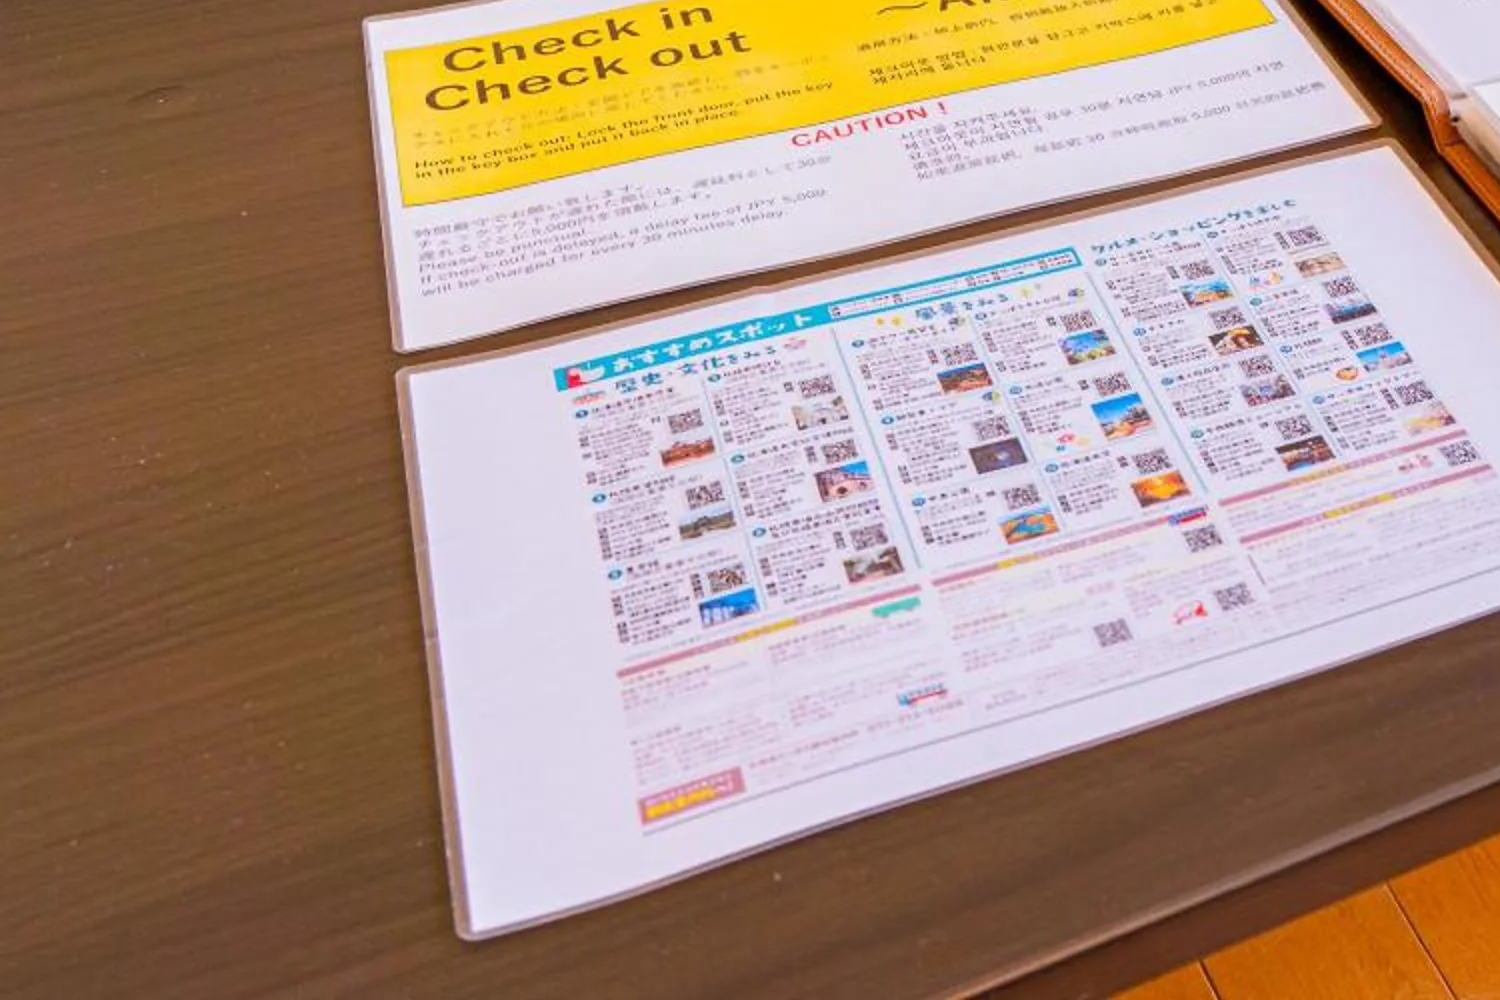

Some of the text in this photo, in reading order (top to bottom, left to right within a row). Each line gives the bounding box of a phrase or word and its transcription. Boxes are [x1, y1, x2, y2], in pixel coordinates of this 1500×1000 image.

[443, 5, 713, 73] Check in
[425, 31, 753, 112] Check out
[414, 158, 453, 170] How
[459, 154, 478, 163] to
[482, 142, 533, 159] check
[621, 119, 648, 129] the
[790, 103, 929, 148] CAUTION
[418, 255, 478, 273] Please
[614, 315, 810, 372] おすすめスポット
